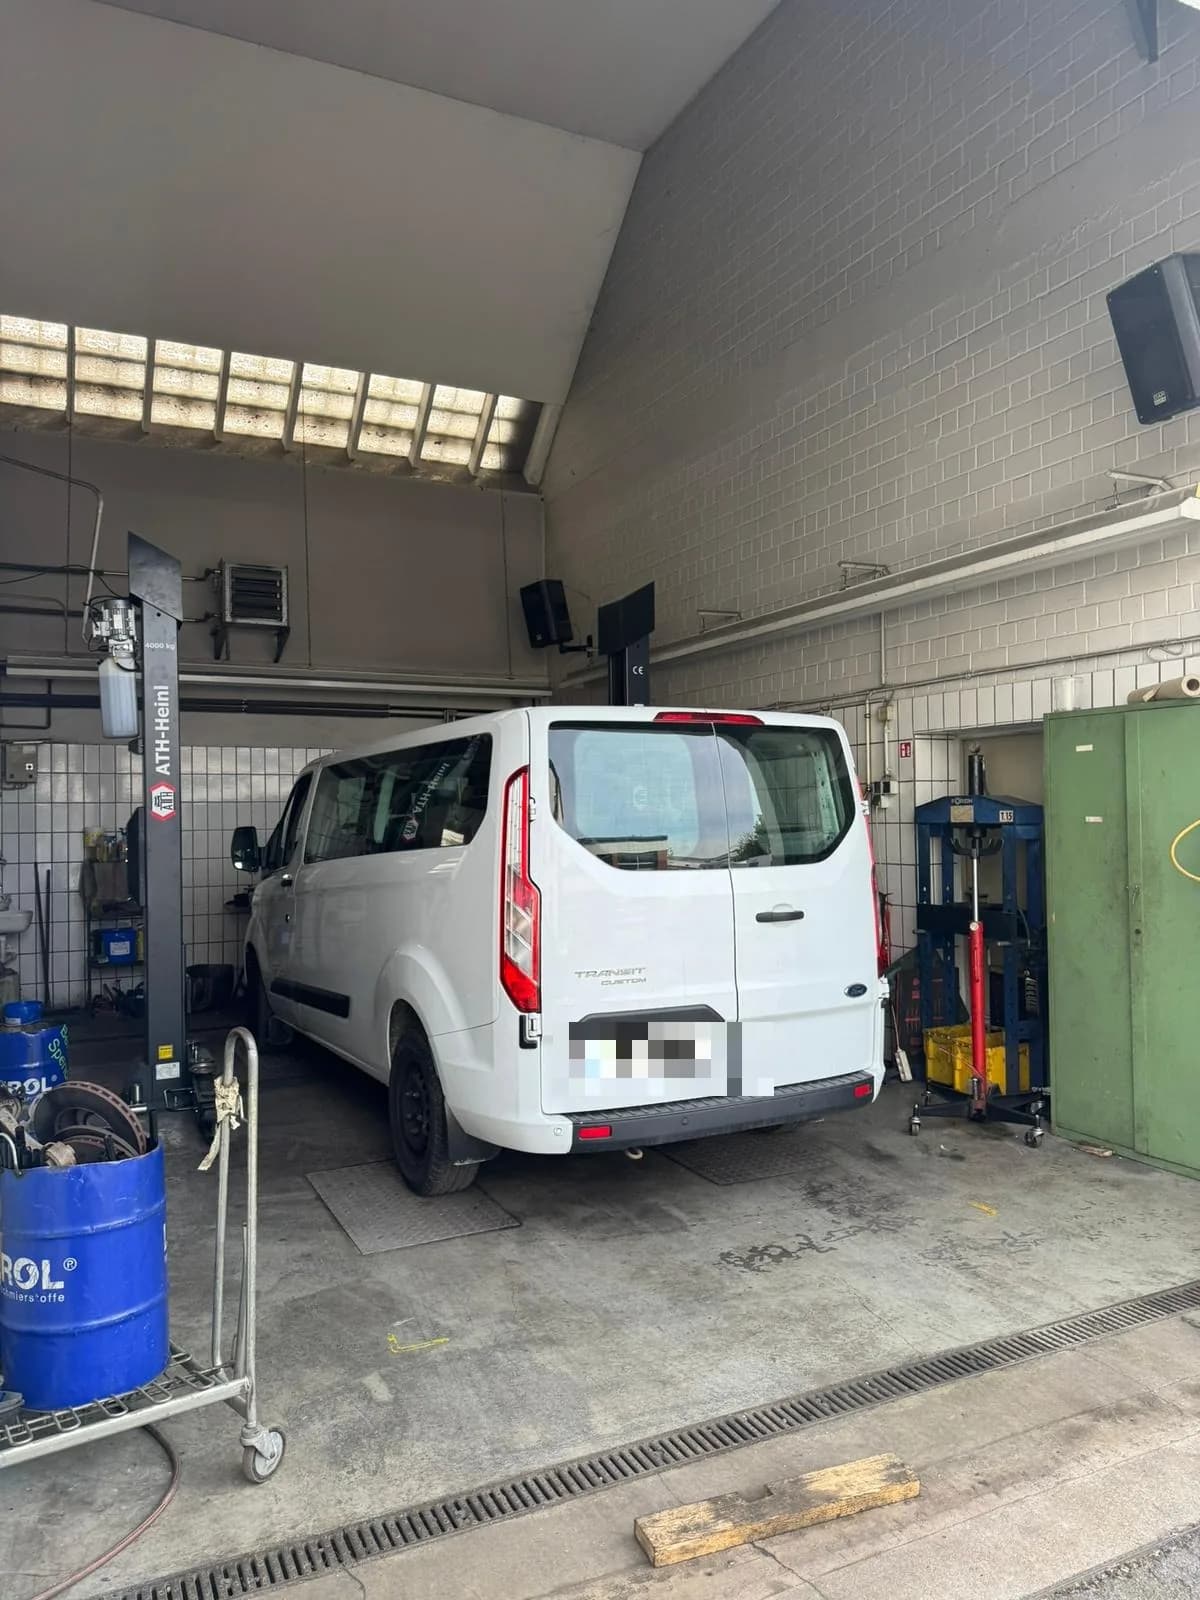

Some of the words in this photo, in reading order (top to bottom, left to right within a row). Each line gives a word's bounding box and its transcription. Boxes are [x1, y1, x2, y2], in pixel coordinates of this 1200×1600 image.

[153, 685, 171, 776] ATH-Heinl
[160, 791, 174, 810] ATH
[574, 967, 647, 979] TRANSIT
[600, 977, 647, 986] CUSTOM
[1, 1077, 53, 1096] ROL
